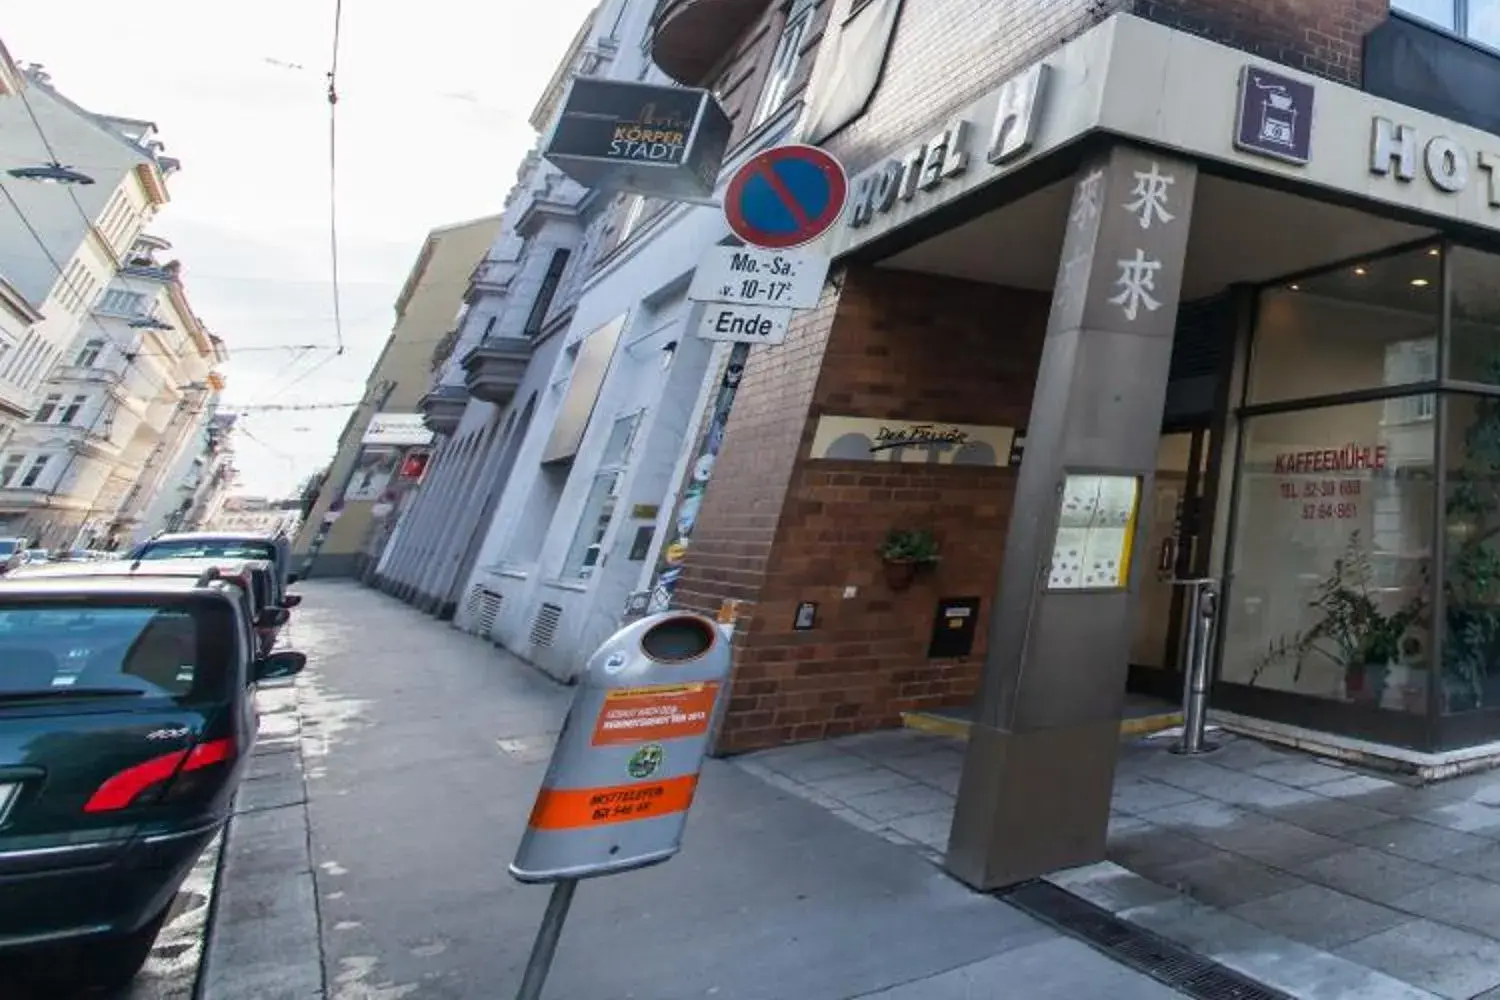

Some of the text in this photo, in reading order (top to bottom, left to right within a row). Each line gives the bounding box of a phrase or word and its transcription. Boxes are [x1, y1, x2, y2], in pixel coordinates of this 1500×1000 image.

[612, 126, 684, 145] KÖRPER
[607, 139, 684, 160] STADT
[848, 117, 971, 228] HOTEL
[715, 311, 773, 335] Ende
[1274, 445, 1388, 474] KAFFEEMÜHLE
